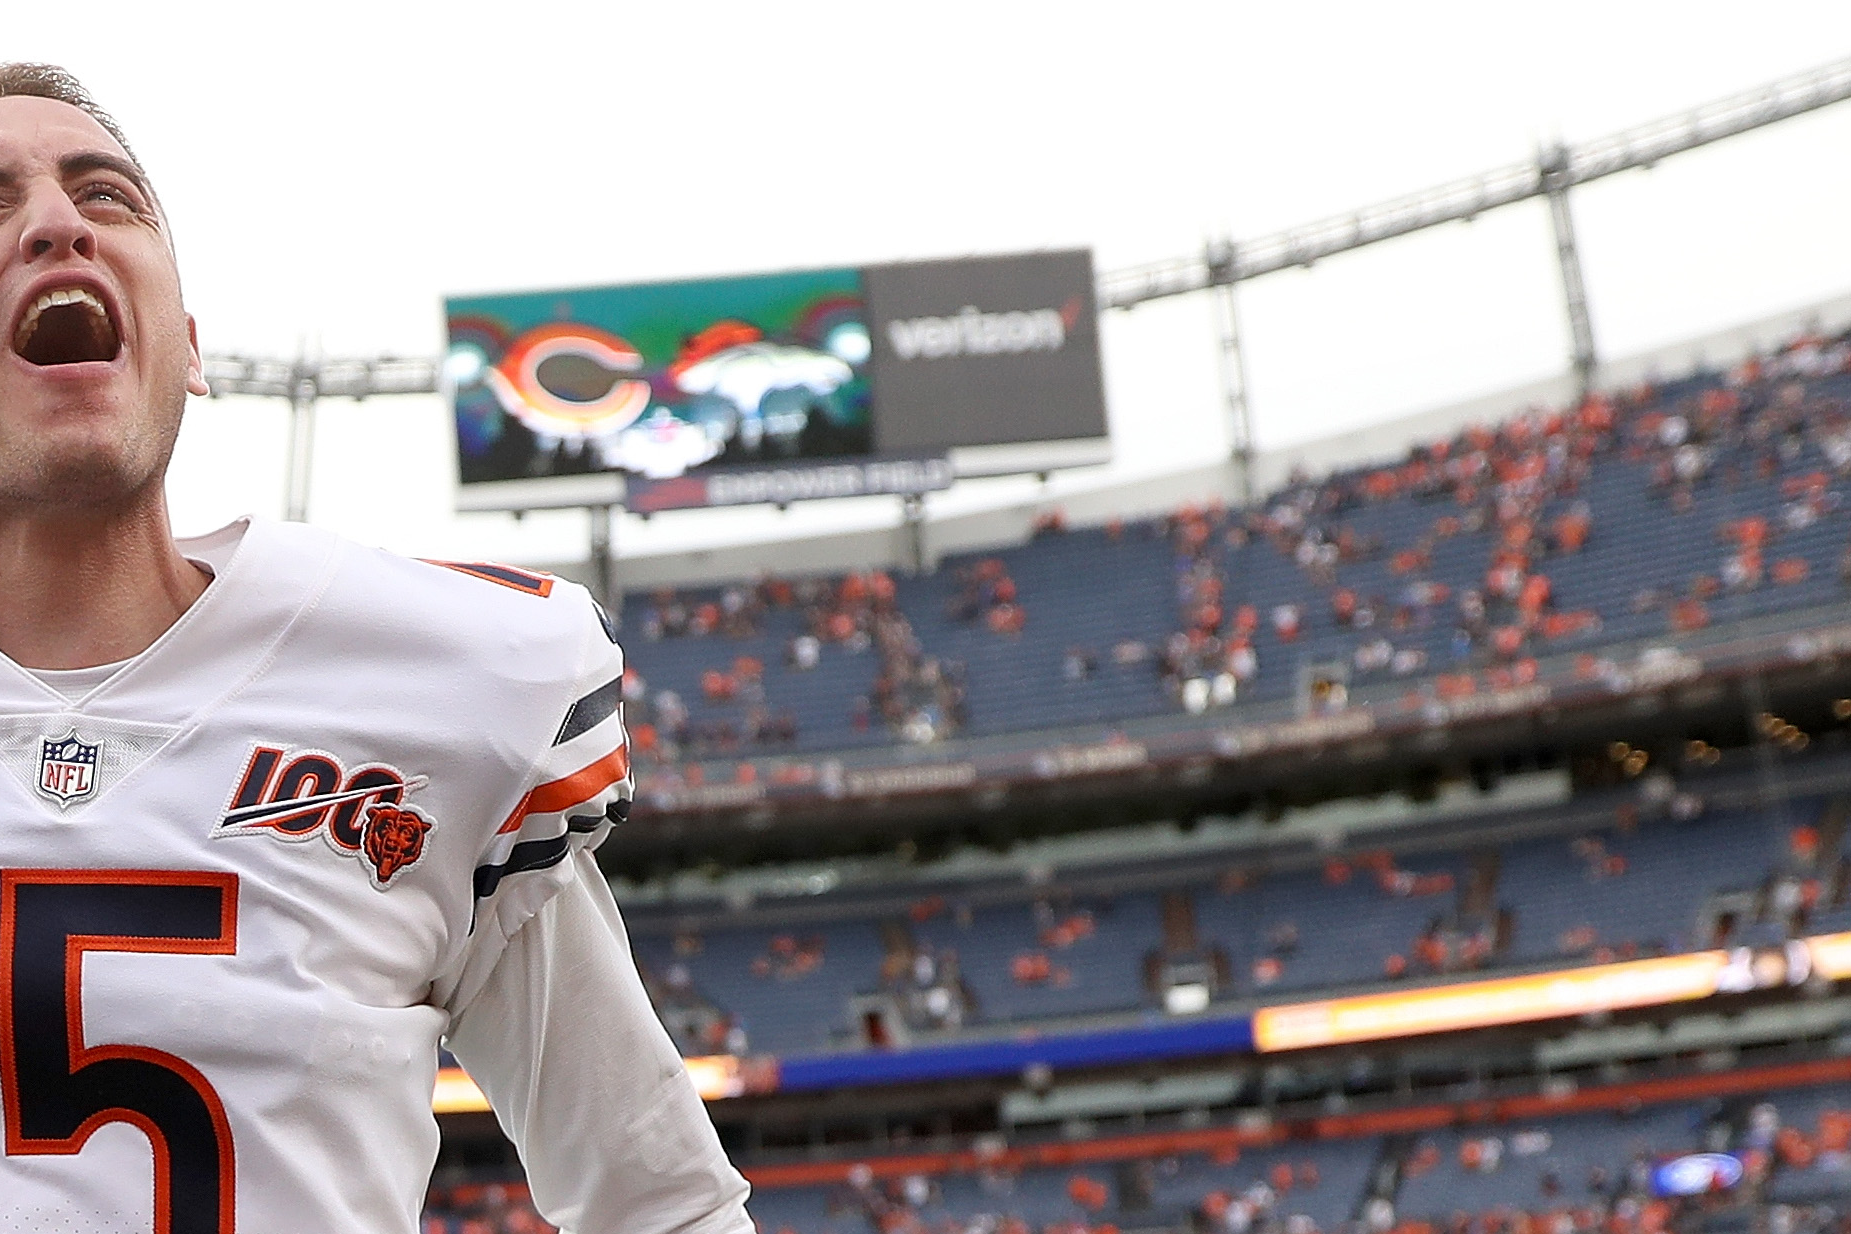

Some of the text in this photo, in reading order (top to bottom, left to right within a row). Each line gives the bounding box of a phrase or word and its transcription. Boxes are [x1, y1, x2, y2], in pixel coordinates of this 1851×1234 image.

[887, 304, 1066, 360] verizon
[708, 459, 951, 506] EMPOWER FIELD
[44, 762, 89, 795] NFL
[223, 745, 405, 850] 100
